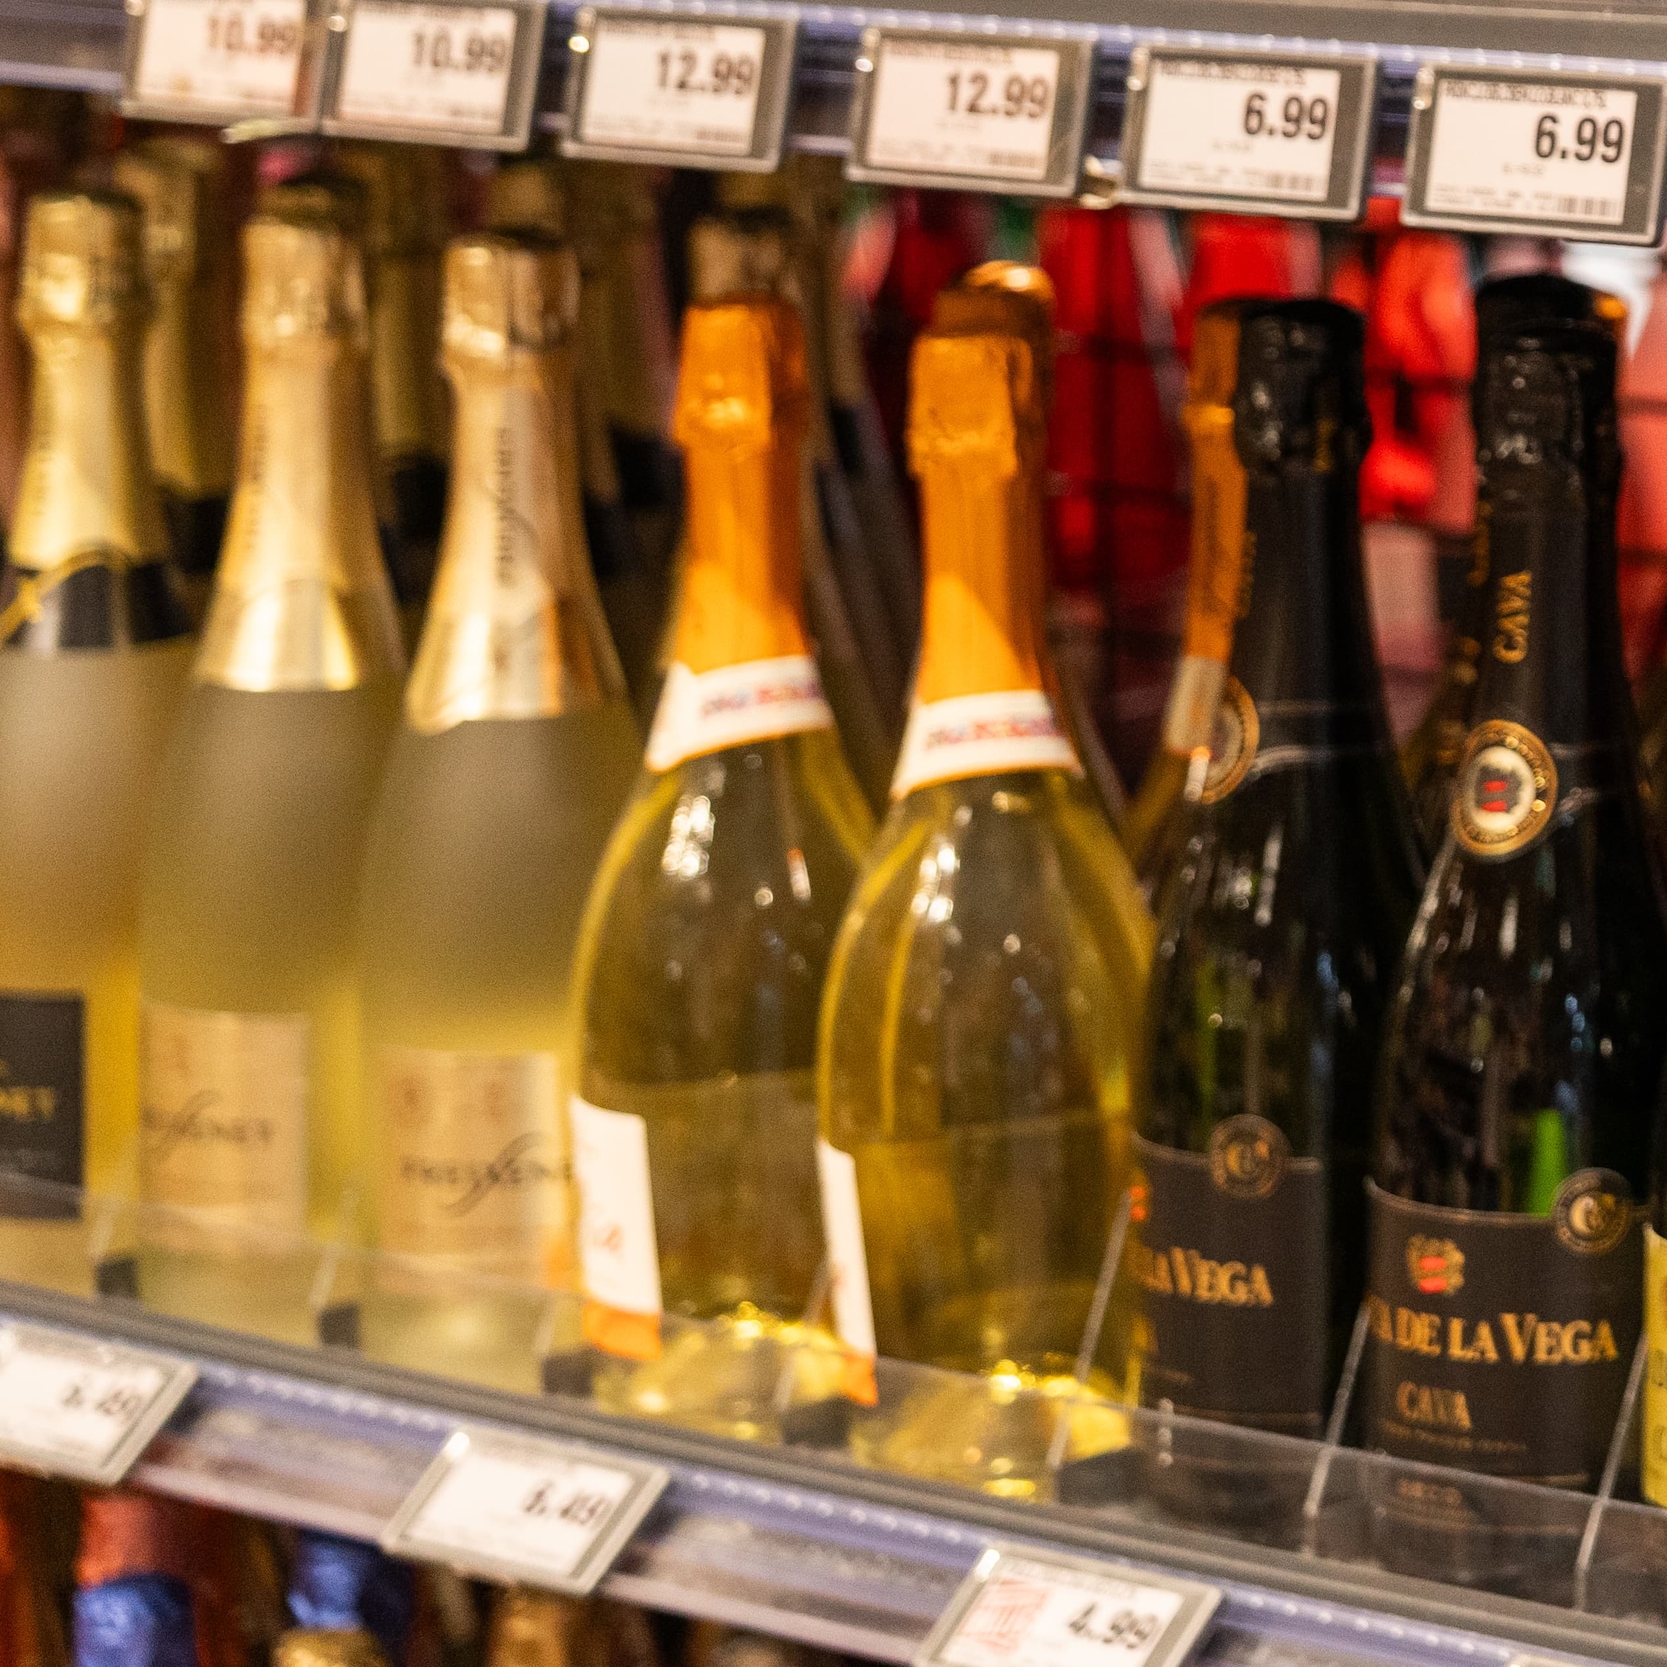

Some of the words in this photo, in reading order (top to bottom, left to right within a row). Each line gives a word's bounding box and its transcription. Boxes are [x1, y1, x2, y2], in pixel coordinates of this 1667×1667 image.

[207, 13, 293, 57] 10.99
[412, 30, 506, 75] 10.99
[656, 51, 754, 98] 12.99
[944, 68, 1048, 120] 12.99
[1244, 92, 1329, 142] 6.99
[1533, 113, 1624, 164] 6.99
[1492, 569, 1532, 663] CAVA
[1170, 1246, 1274, 1308] VEGA
[1399, 1307, 1441, 1357] DE
[1448, 1318, 1498, 1363] LA
[1501, 1312, 1619, 1366] VEGA
[1398, 1382, 1472, 1431] CAVA
